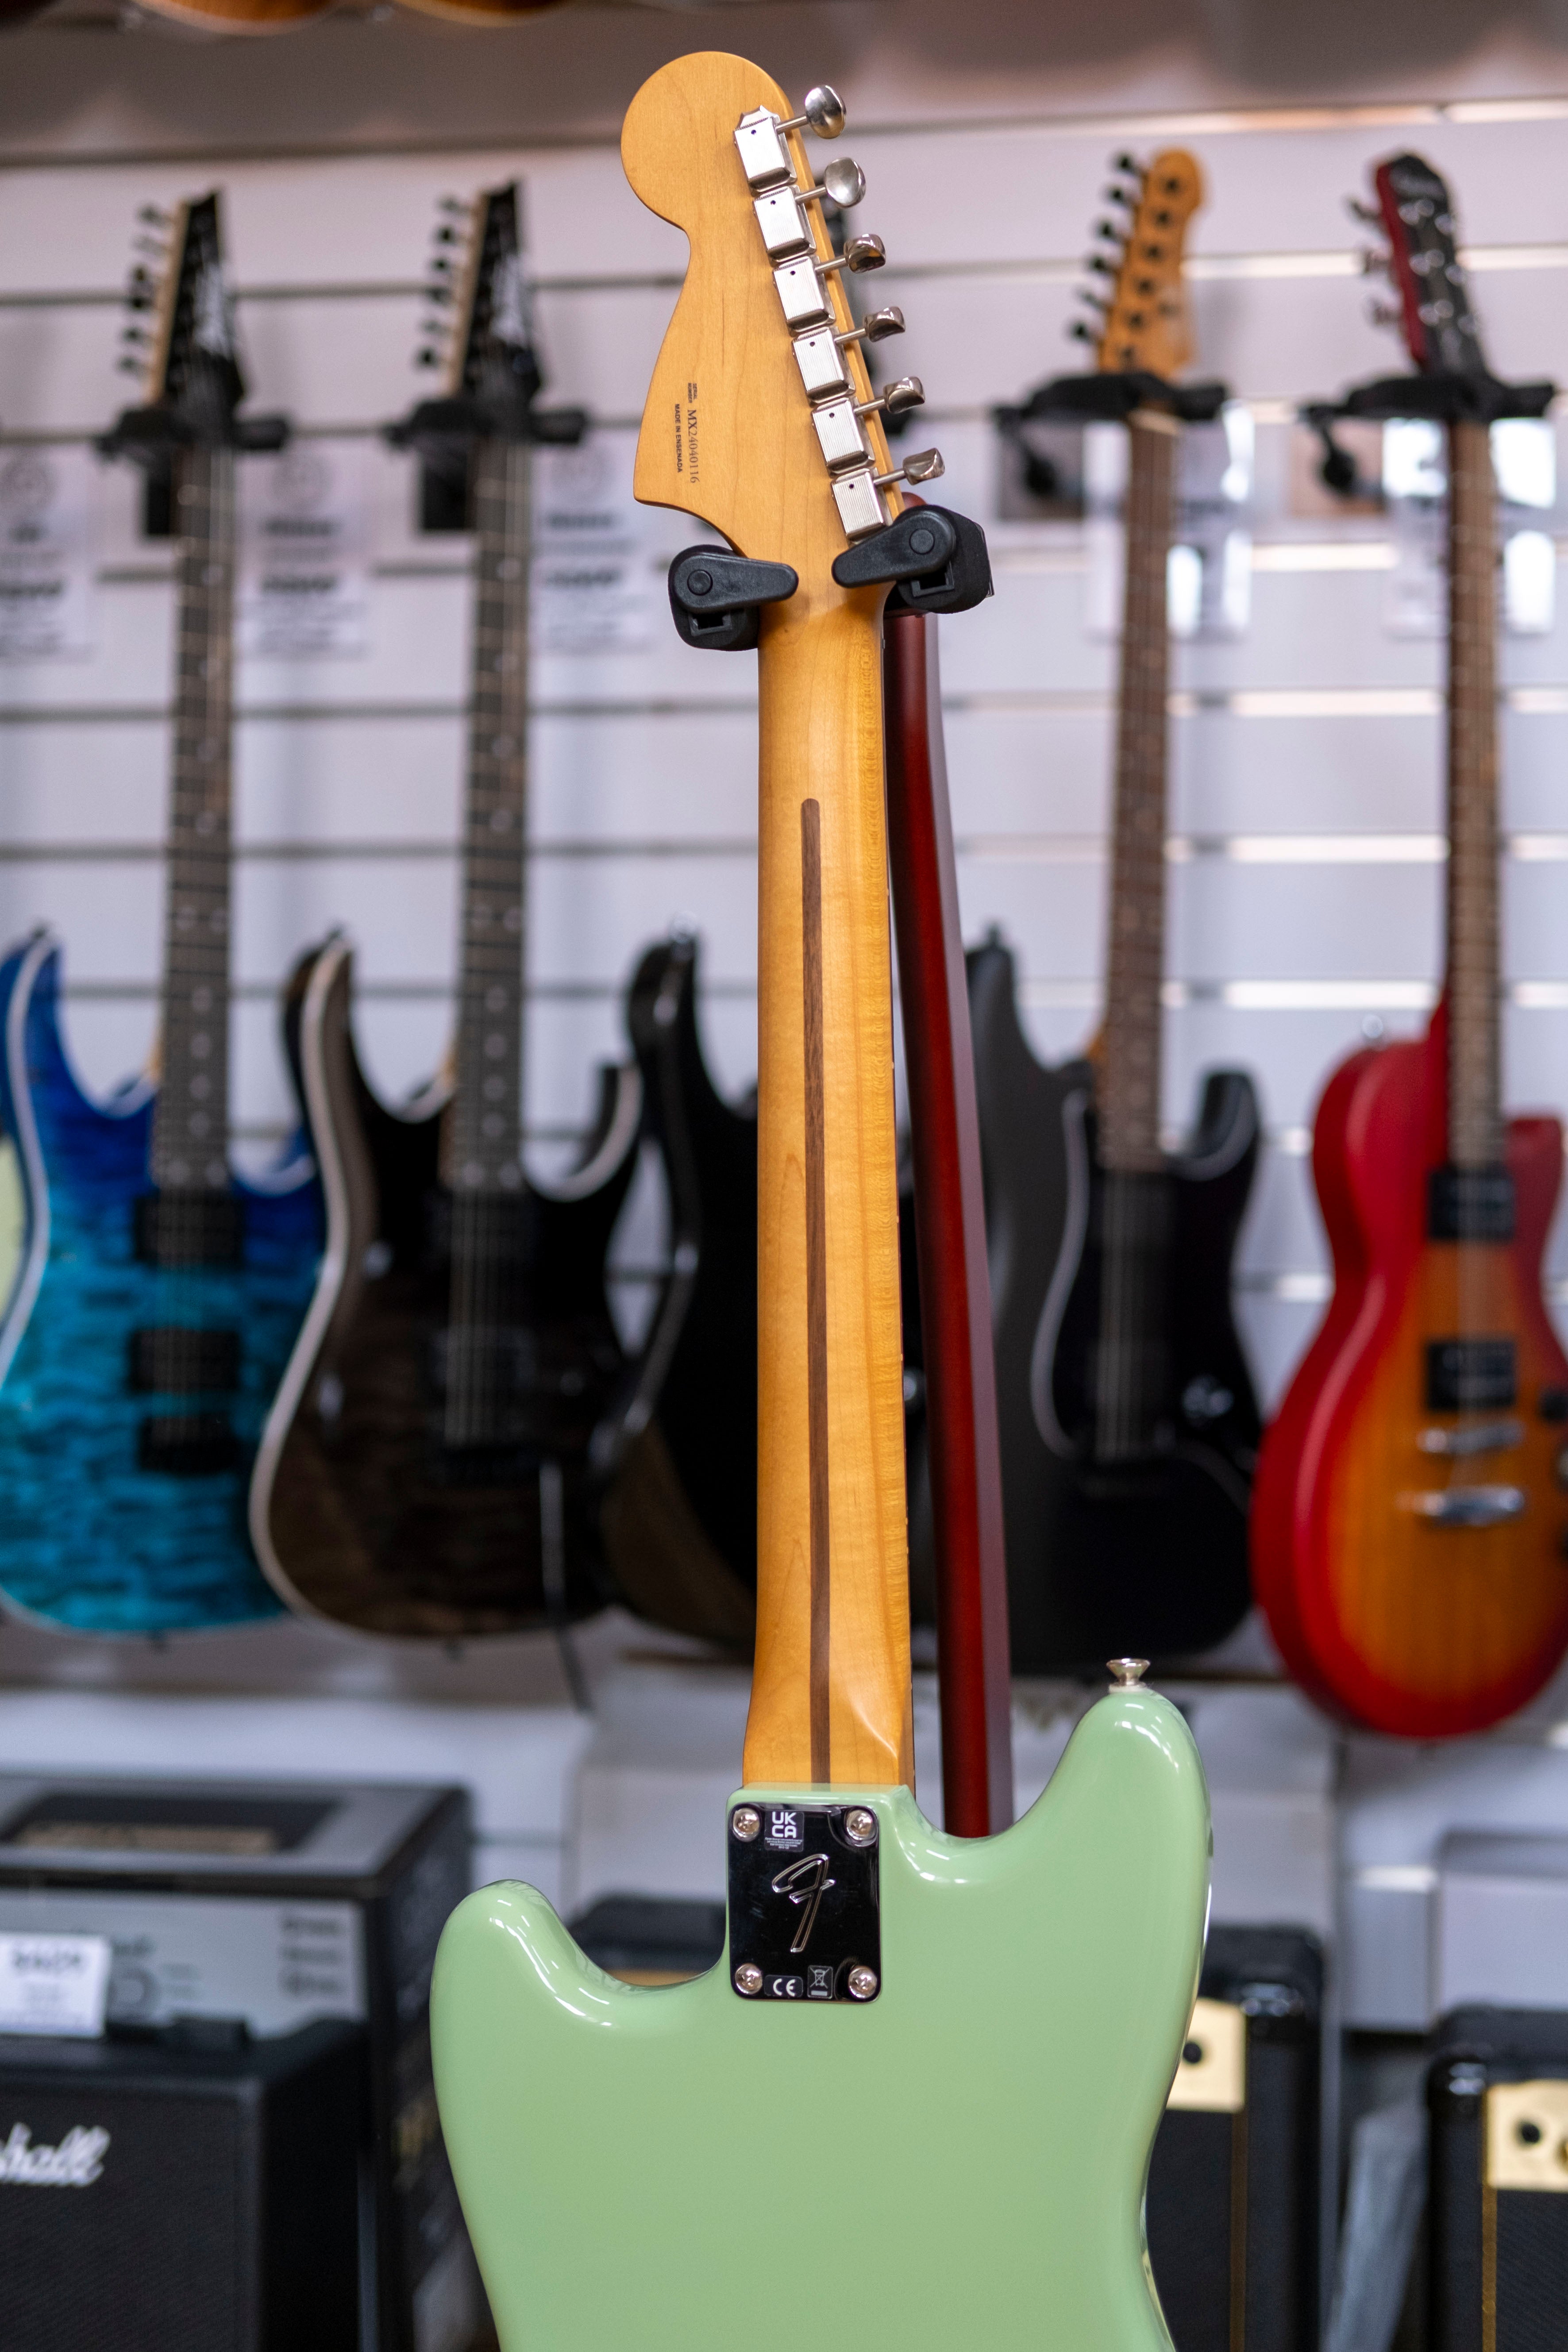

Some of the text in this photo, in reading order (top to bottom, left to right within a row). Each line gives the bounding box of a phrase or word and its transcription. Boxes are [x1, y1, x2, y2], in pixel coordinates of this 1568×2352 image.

[688, 409, 700, 483] MX24040116
[772, 1811, 797, 1825] UK
[772, 1825, 797, 1838] CA
